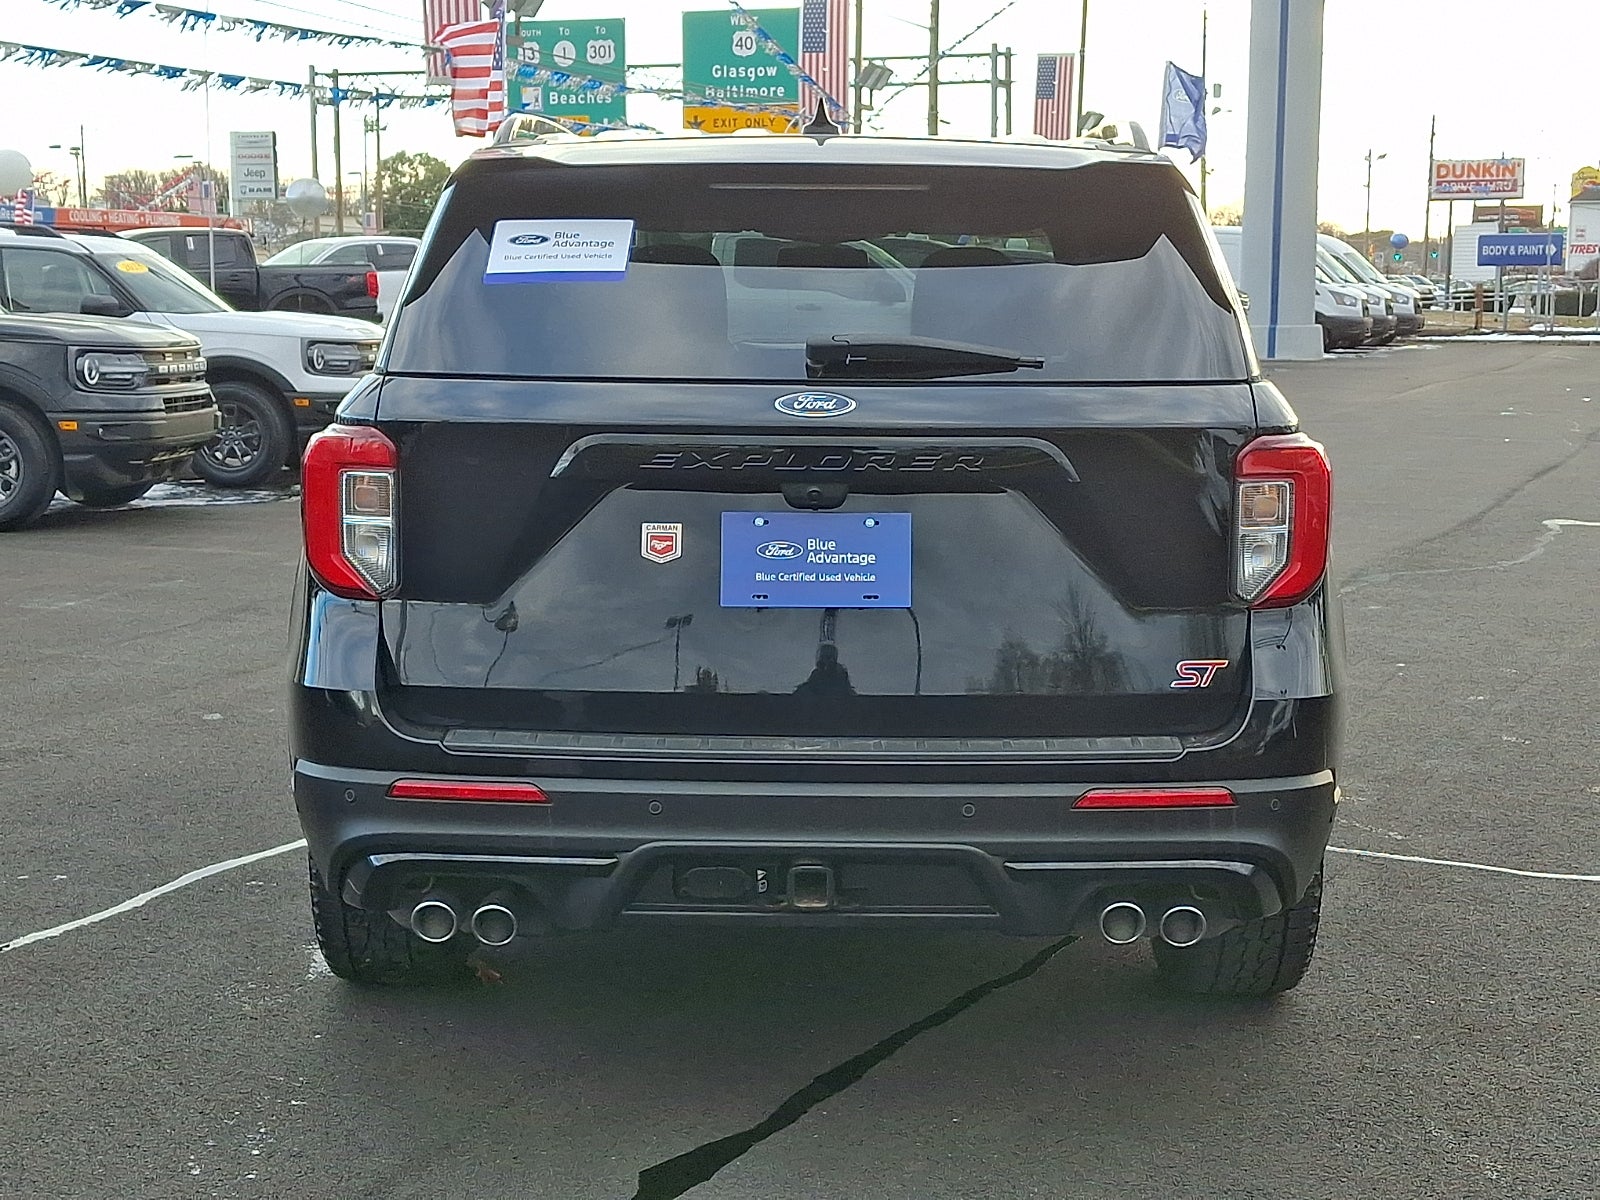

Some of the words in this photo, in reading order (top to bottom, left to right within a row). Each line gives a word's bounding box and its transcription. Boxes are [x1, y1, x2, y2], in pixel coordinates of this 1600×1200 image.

[520, 29, 542, 37] OUTH
[735, 36, 753, 51] 40
[589, 45, 612, 59] 301
[712, 64, 777, 82] Glasgow
[549, 91, 612, 105] Beaches
[705, 85, 785, 98] Baltimore
[713, 118, 737, 128] EXIT
[745, 118, 776, 128] ONLY
[243, 167, 266, 179] Jeep
[1436, 162, 1522, 179] DUNKIN'
[69, 210, 102, 222] COOLING
[108, 213, 139, 224] HEATING
[515, 234, 543, 244] Ford
[554, 231, 580, 239] Blue
[552, 240, 615, 248] Advantage
[1482, 246, 1507, 255] BODY
[1509, 246, 1516, 255] &
[1518, 245, 1544, 255] PAINT
[1570, 244, 1598, 254] TIRES
[793, 395, 837, 410] Ford
[640, 450, 984, 470] EXPLORER
[765, 543, 794, 556] Ford
[807, 538, 836, 550] Blue
[806, 552, 876, 565] Advantage
[755, 572, 776, 581] Blue
[778, 572, 815, 582] Certified
[819, 573, 841, 581] Used
[844, 573, 876, 581] Vehicle
[1170, 660, 1229, 687] ST
